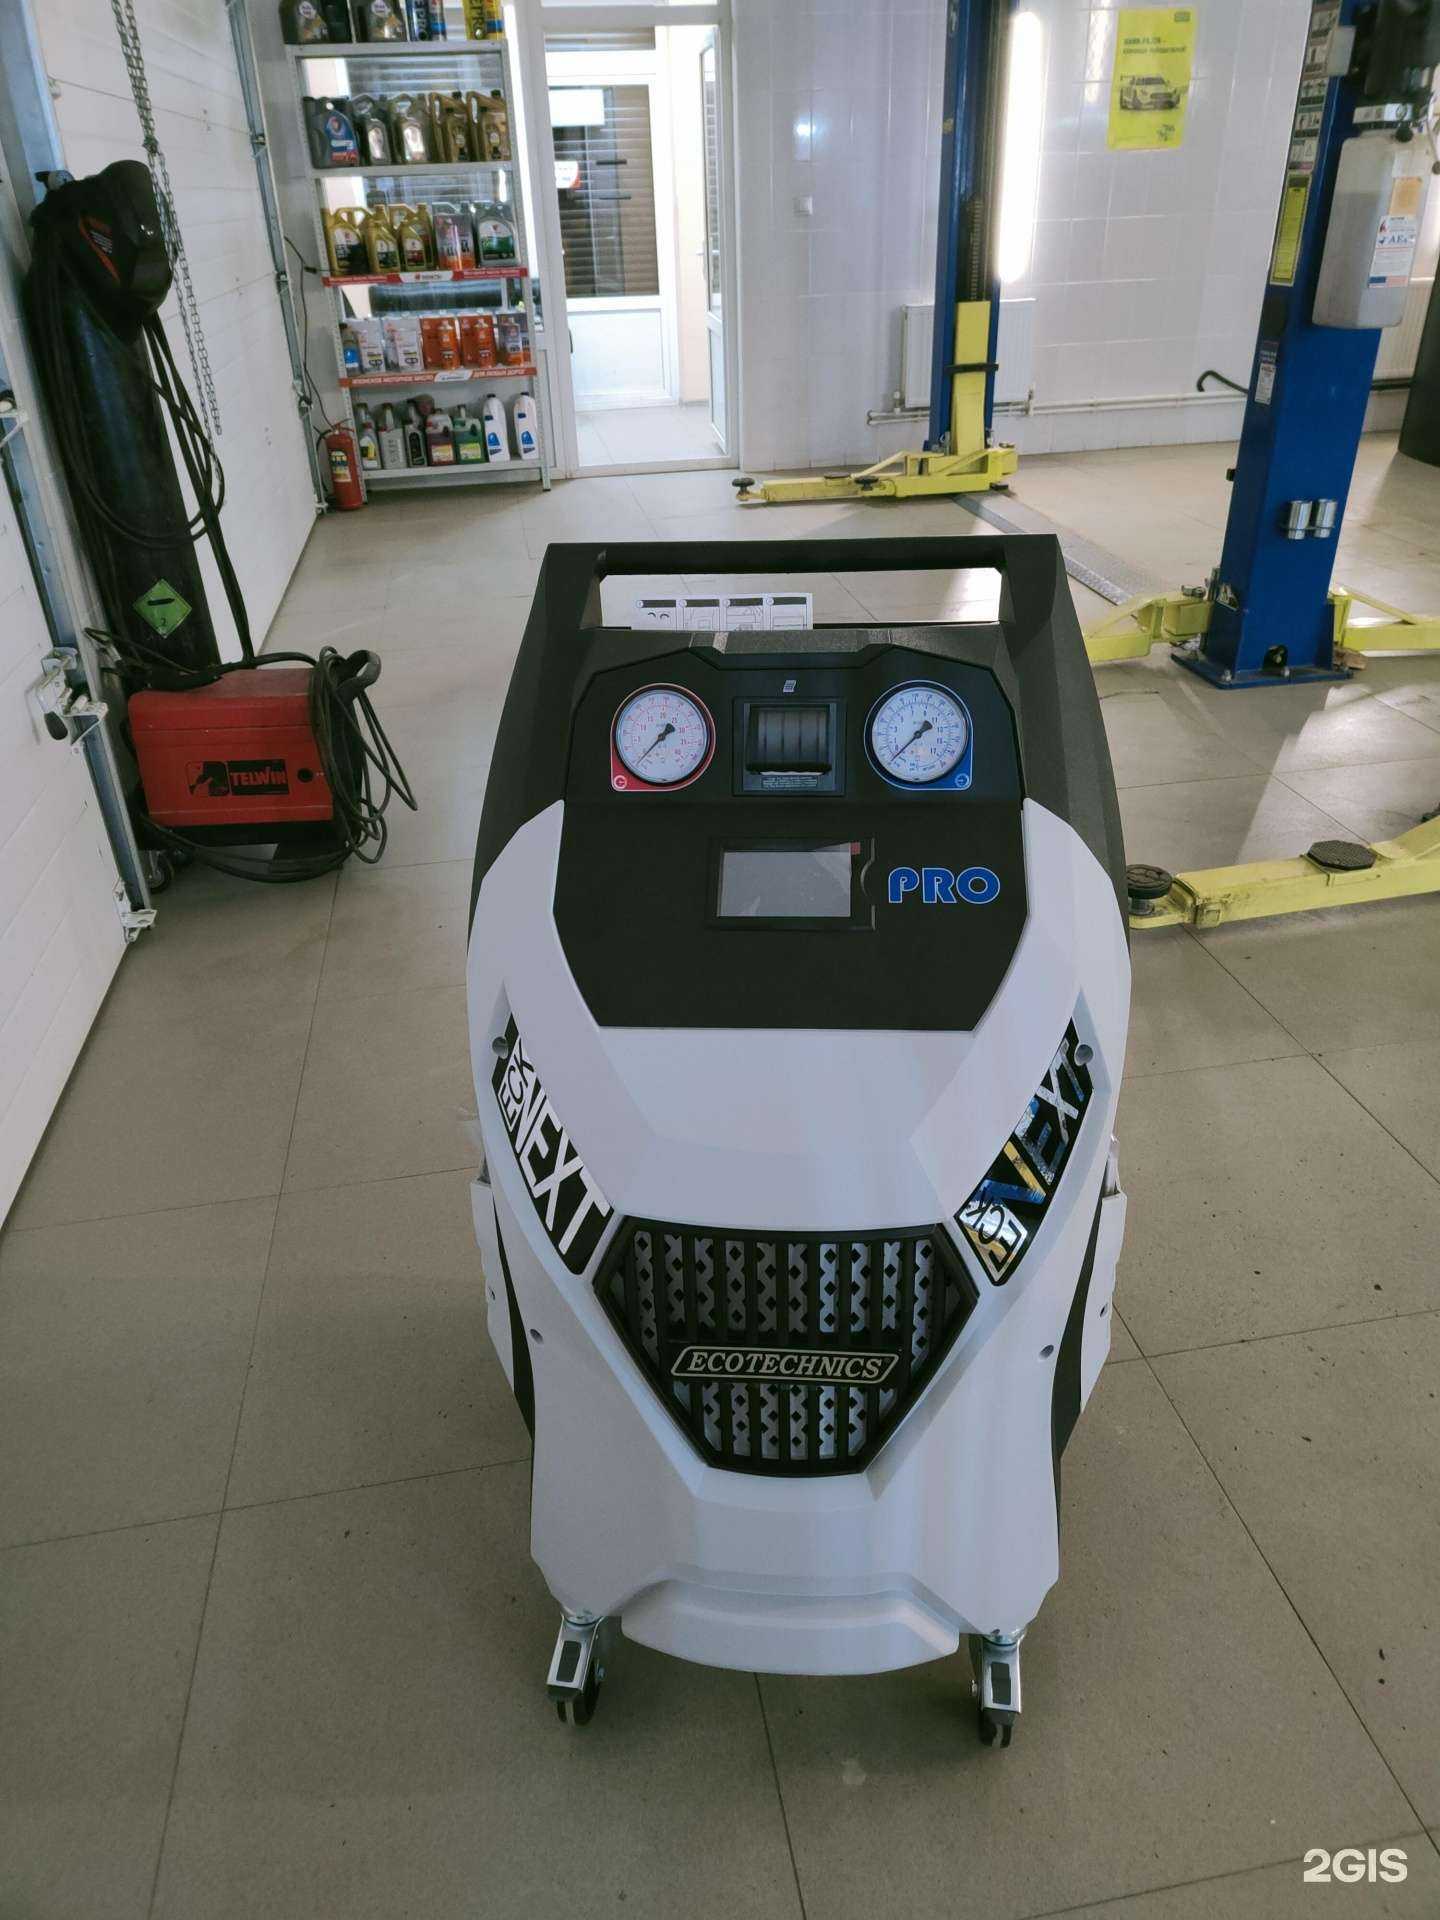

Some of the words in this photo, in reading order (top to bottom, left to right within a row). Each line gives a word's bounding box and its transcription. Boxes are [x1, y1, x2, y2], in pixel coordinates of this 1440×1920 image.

[230, 766, 288, 786] TELWIN
[888, 865, 1001, 905] PRO
[974, 1036, 1087, 1206] NEXT
[514, 1075, 613, 1256] NEXT
[686, 1350, 884, 1380] ECOTECHNICS
